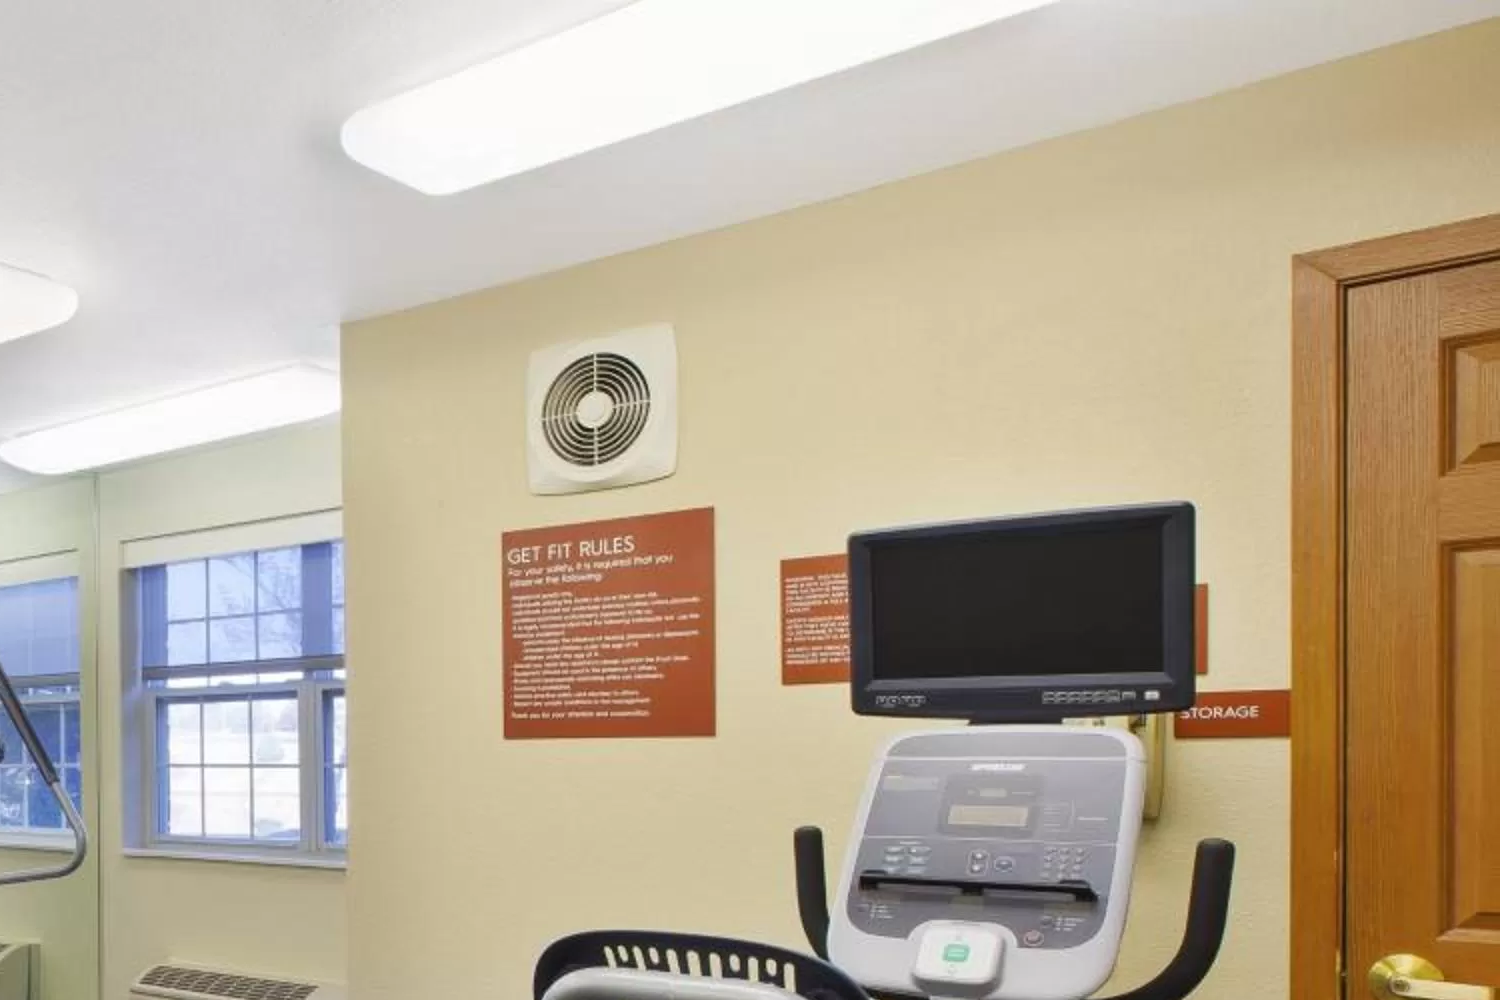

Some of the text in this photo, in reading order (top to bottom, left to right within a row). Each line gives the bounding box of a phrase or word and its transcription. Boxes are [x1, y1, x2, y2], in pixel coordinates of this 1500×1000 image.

[507, 535, 635, 564] GET FIT RULES
[1180, 705, 1260, 719] STORAGE
